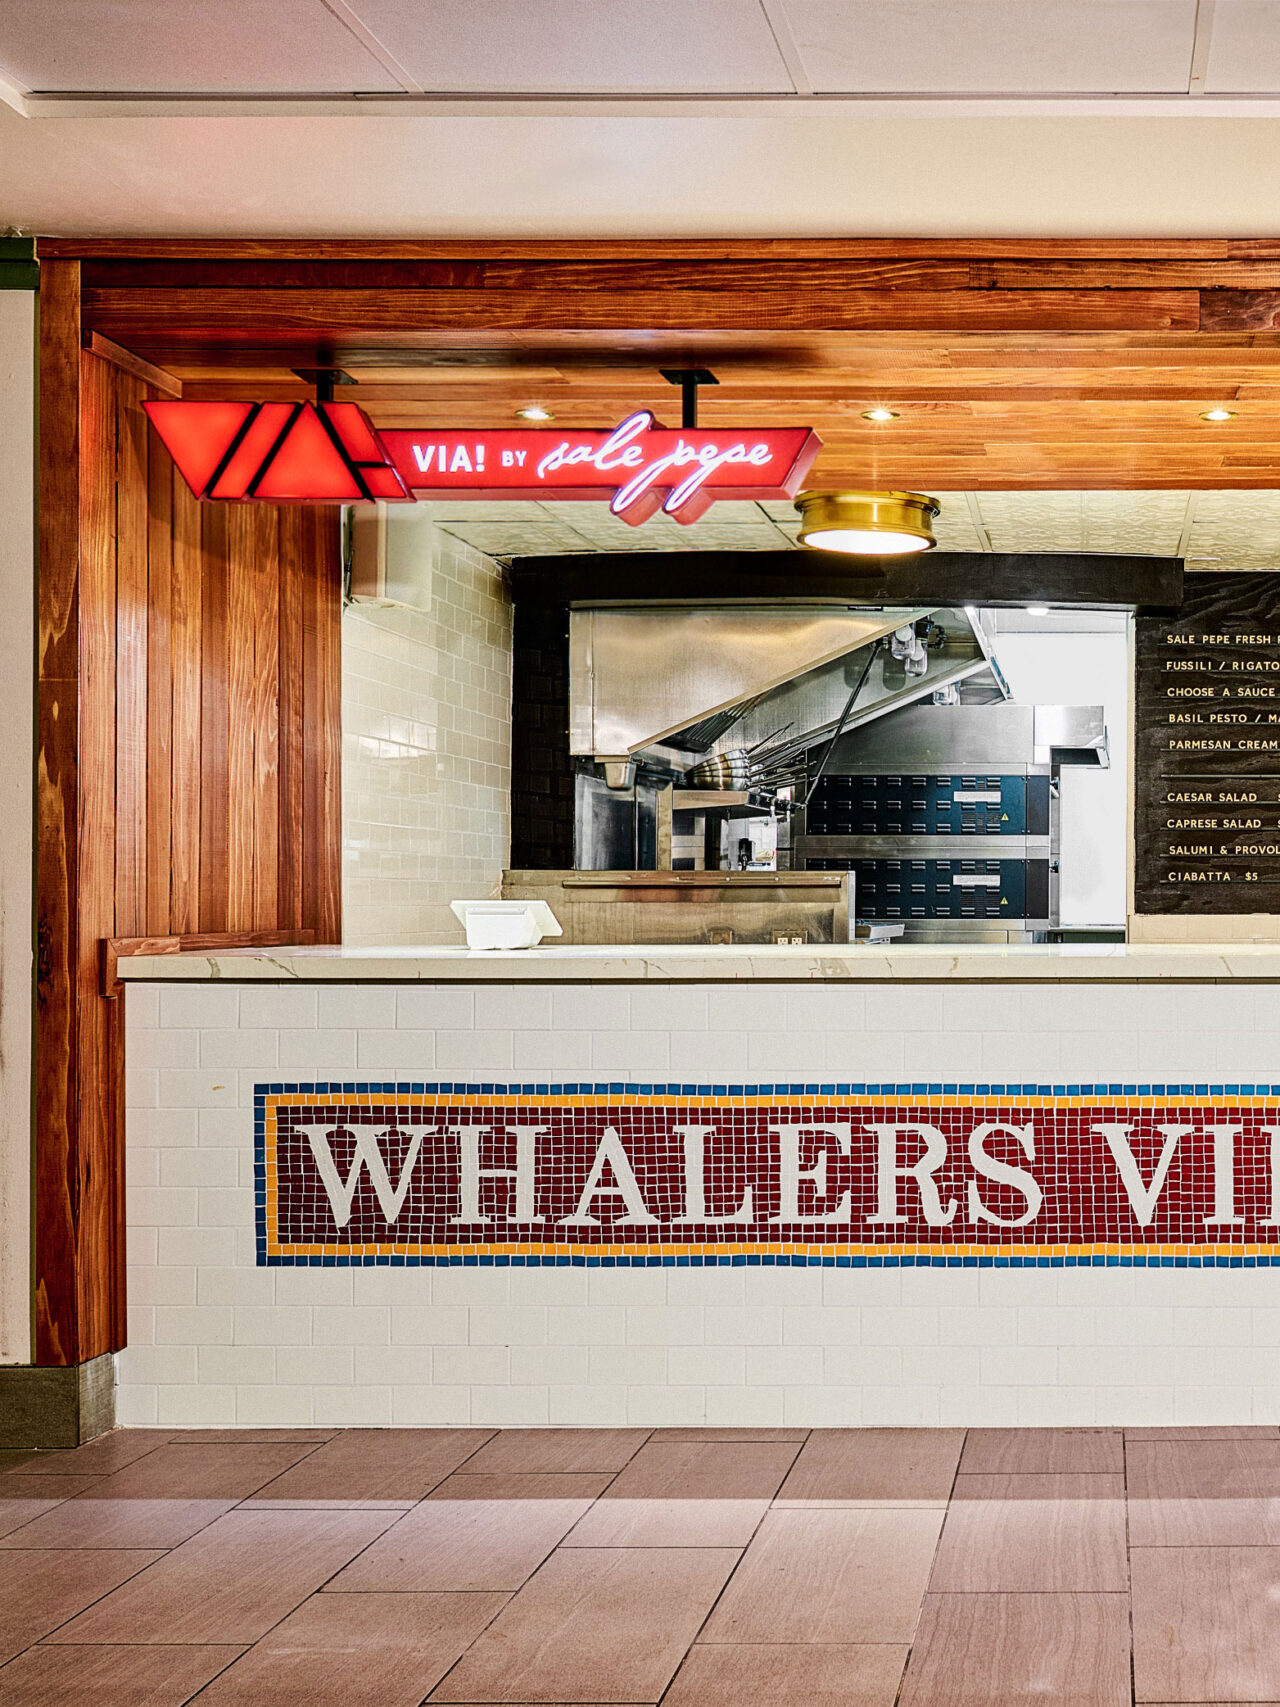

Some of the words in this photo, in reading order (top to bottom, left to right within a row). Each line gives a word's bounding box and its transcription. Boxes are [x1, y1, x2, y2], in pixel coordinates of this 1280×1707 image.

[412, 445, 485, 472] VIA!
[502, 451, 527, 467] BY
[537, 410, 652, 478] sale
[611, 439, 774, 512] pepe
[1167, 635, 1194, 644] SALE
[1202, 635, 1229, 644] PEPE
[1235, 635, 1270, 644] FRESH
[1166, 662, 1211, 671] FUSSILI
[1166, 688, 1214, 696] CHOOSE
[1237, 688, 1275, 696] SAUCE
[1168, 714, 1203, 723] BASIL
[1209, 714, 1247, 723] PESTO
[1169, 740, 1230, 749] PARMESAN
[1237, 740, 1277, 749] CREAM
[1167, 793, 1212, 801] CAESAR
[1218, 793, 1256, 801] SALAD
[1166, 819, 1217, 828] CAPRESE
[1223, 819, 1261, 828] SALAD
[1169, 845, 1212, 854] SALUMI
[1168, 872, 1230, 881] CIABATTA
[1245, 872, 1258, 881] $5
[295, 1122, 1043, 1229] WHALERS
